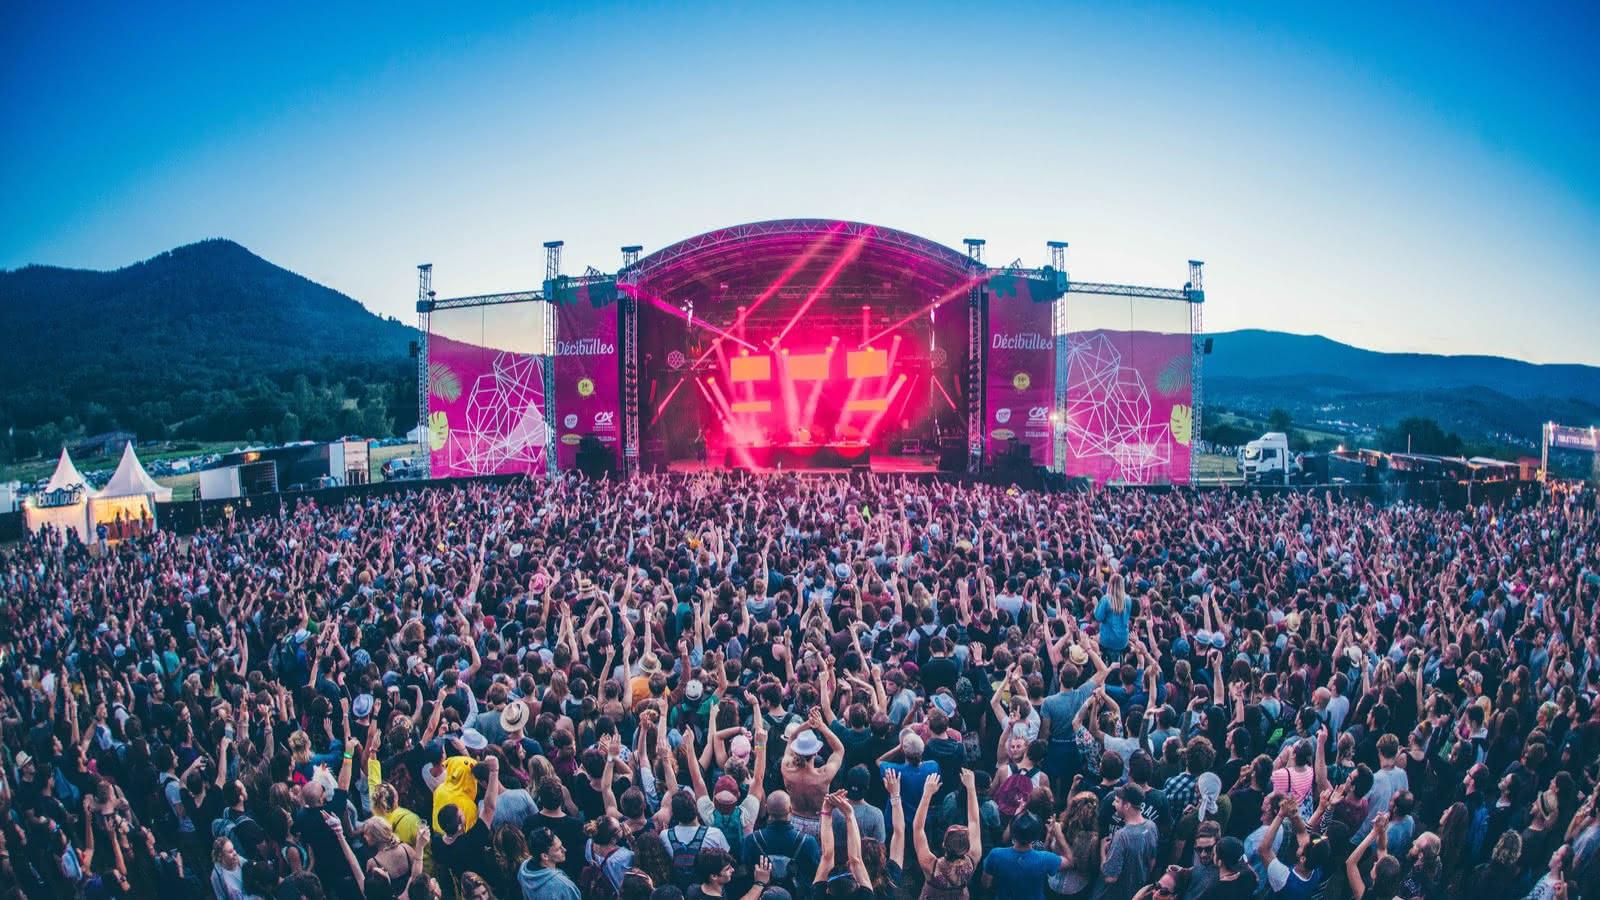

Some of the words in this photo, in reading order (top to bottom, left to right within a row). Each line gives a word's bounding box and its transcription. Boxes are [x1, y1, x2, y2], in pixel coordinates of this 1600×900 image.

[556, 338, 614, 355] Décibulles
[992, 332, 1053, 349] Décibulles
[38, 490, 80, 507] Boutique
